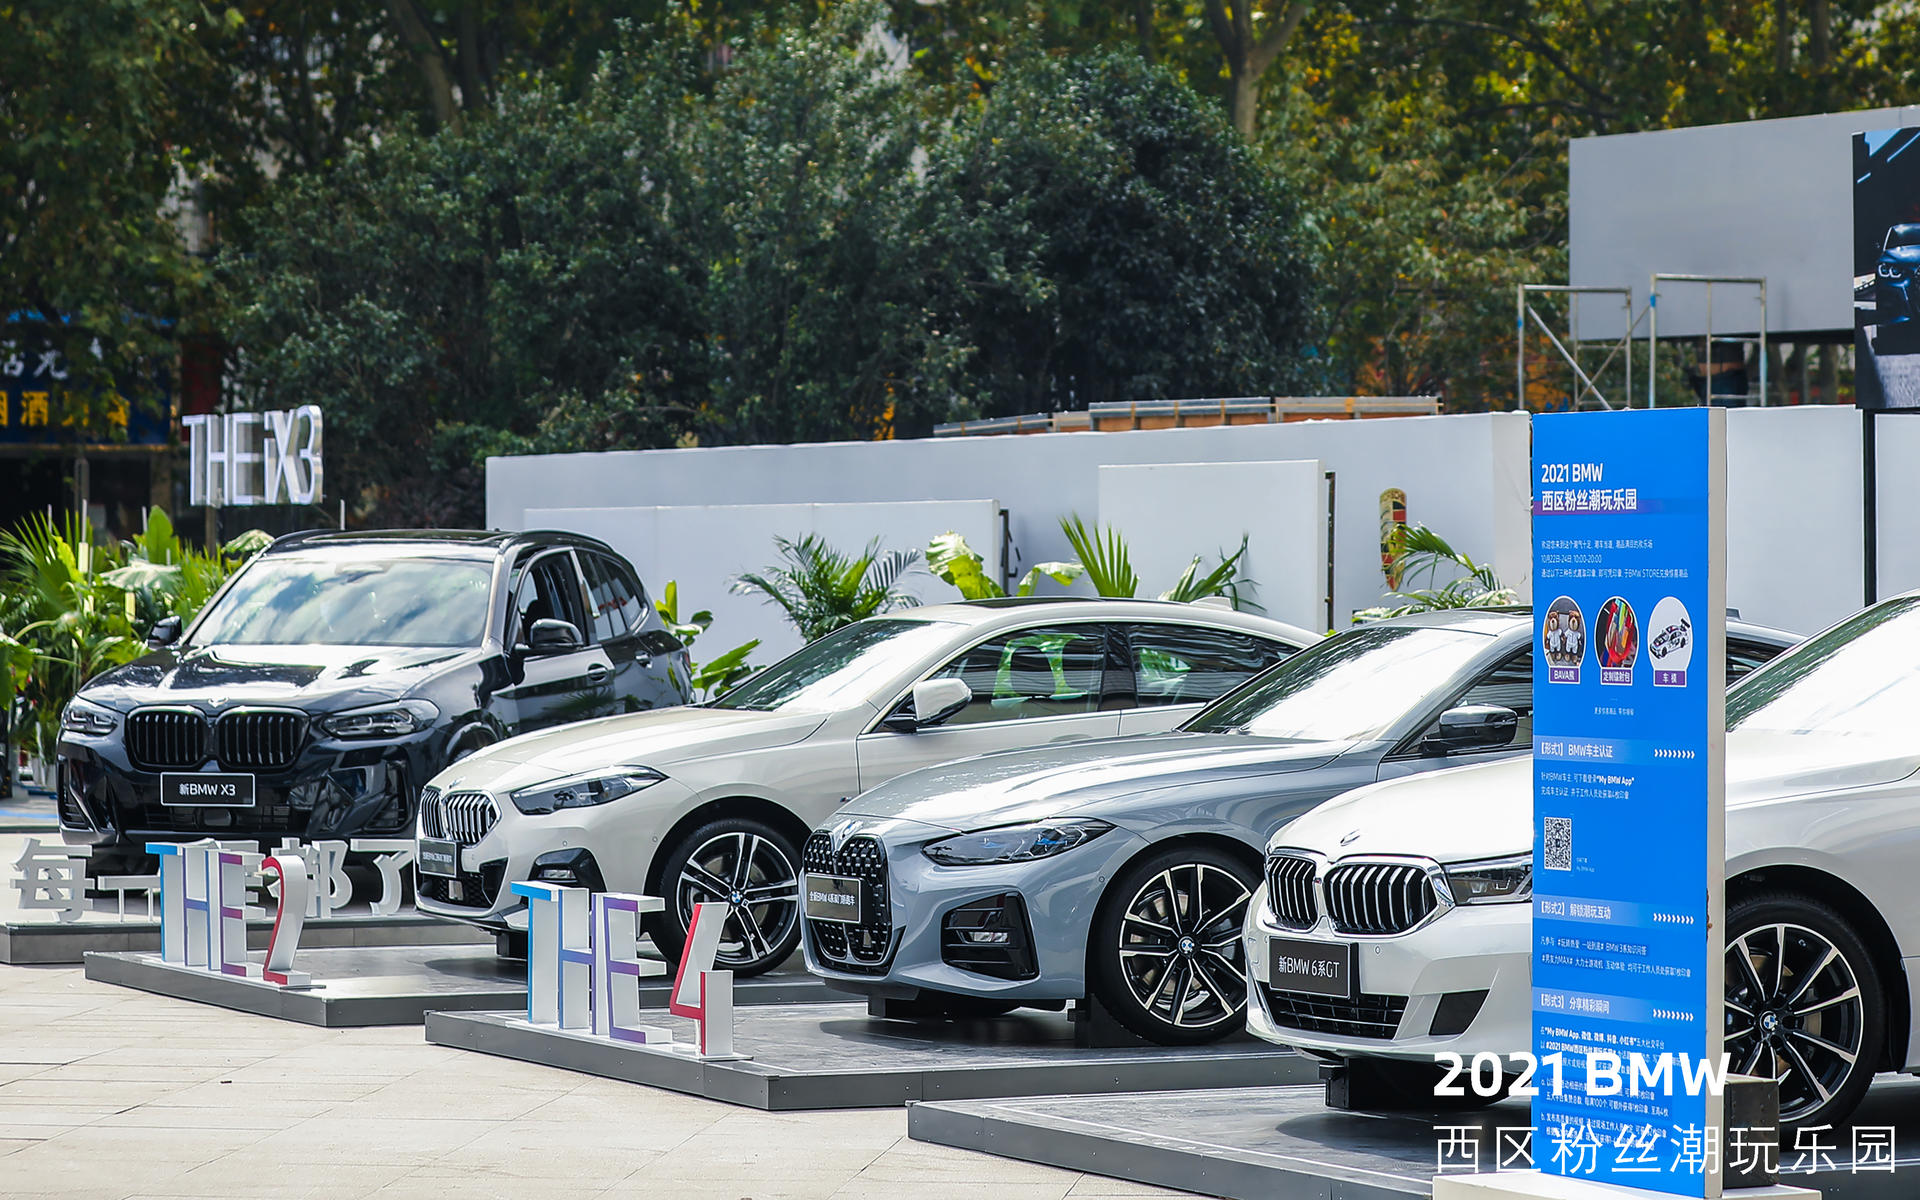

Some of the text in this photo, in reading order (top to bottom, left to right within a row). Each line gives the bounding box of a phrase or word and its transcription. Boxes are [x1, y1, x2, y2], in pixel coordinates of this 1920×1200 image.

[182, 413, 262, 506] THE
[1541, 462, 1603, 483] 2021 BMW
[1541, 488, 1637, 512] 西区粉丝潮玩乐园
[1541, 742, 1613, 759] 【形式1】 BMW车主认证
[179, 783, 236, 796] 新BMW X3
[1607, 775, 1621, 785] BMW
[145, 842, 311, 985] THE 2
[1541, 900, 1565, 916] 【形式2】
[510, 880, 733, 1057] THE 4
[1278, 955, 1340, 978] 新BMW 6系GT
[1541, 993, 1610, 1014] 【形式3】 分享精彩瞬间
[1555, 1027, 1569, 1038] BMW
